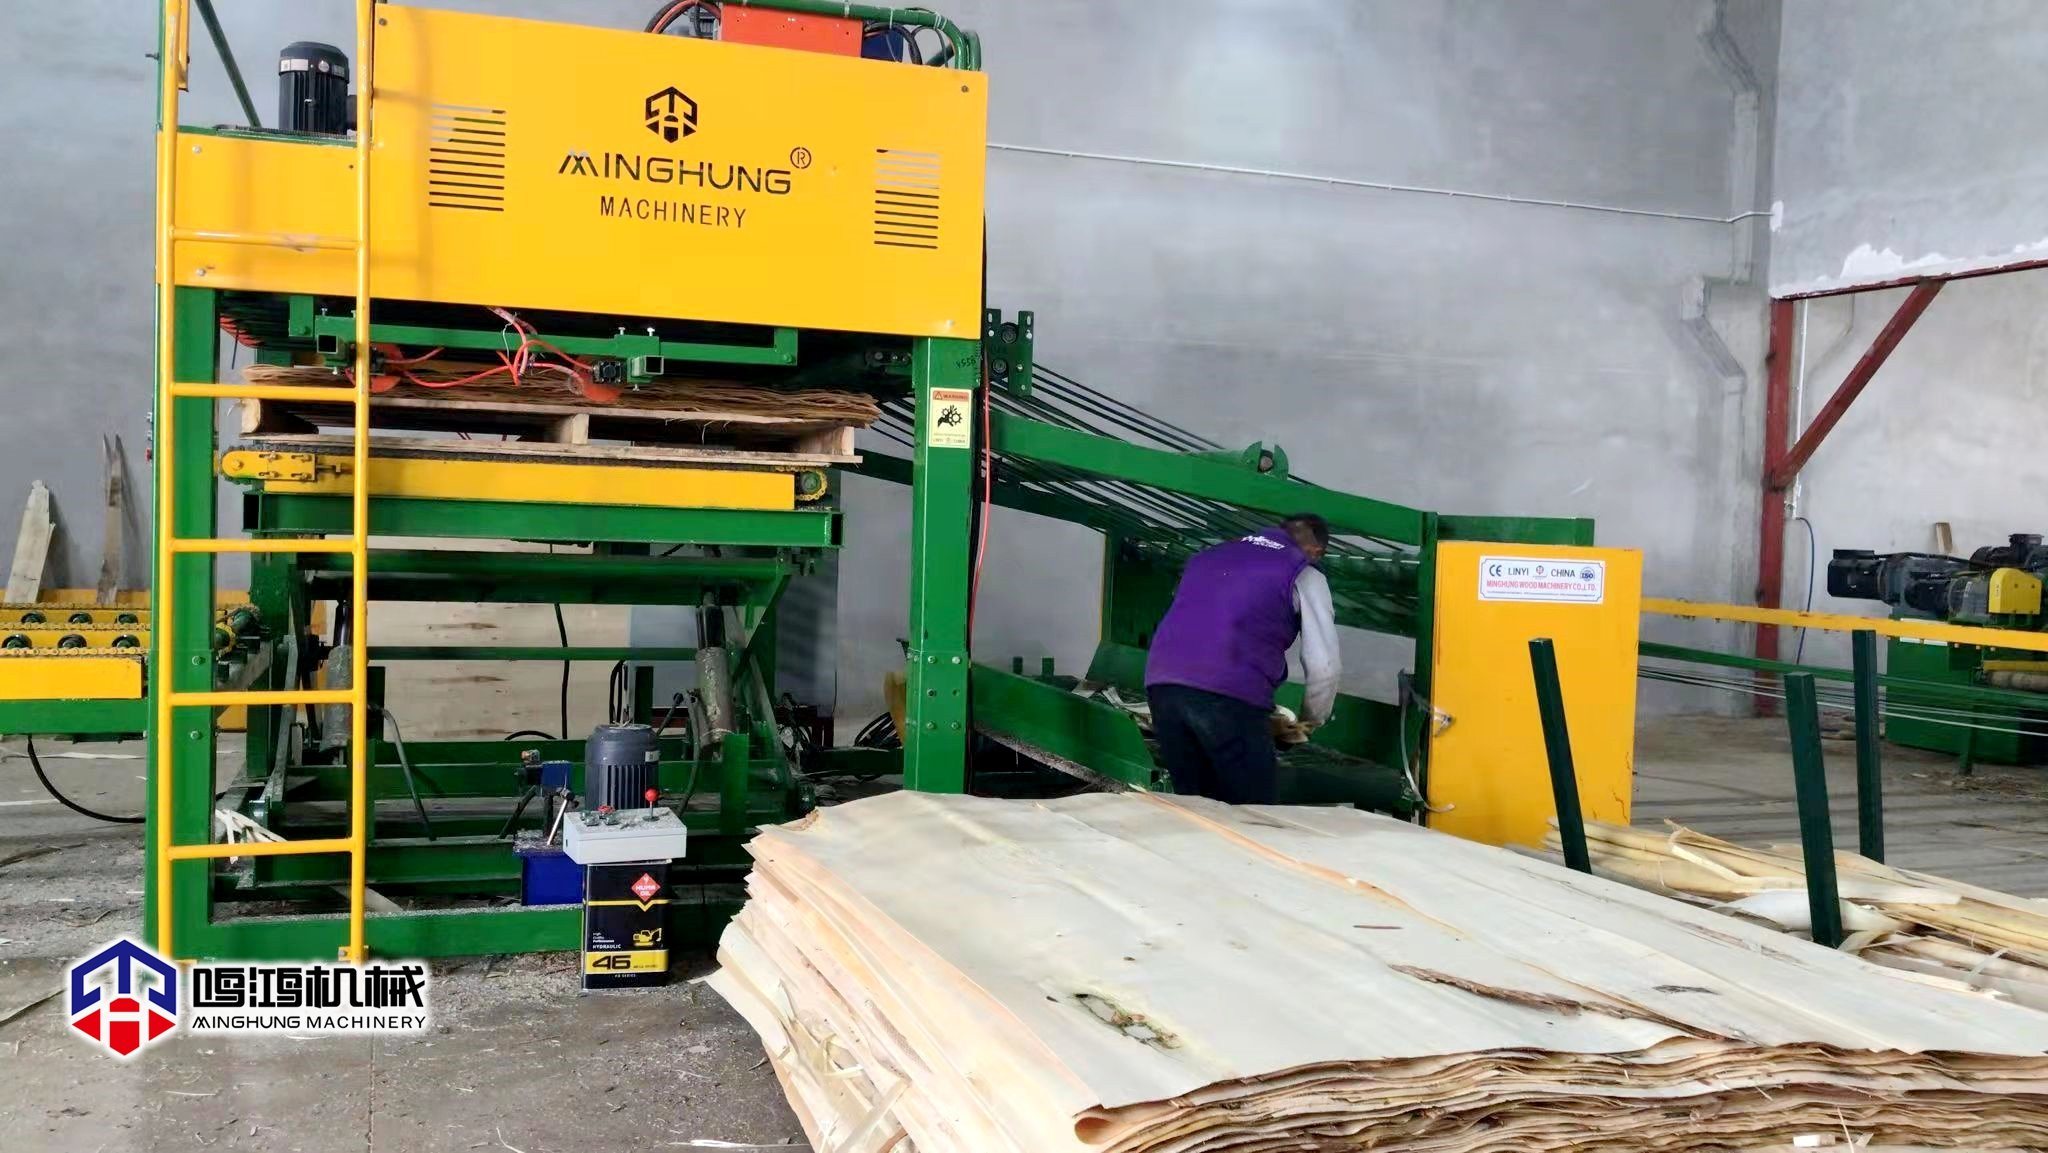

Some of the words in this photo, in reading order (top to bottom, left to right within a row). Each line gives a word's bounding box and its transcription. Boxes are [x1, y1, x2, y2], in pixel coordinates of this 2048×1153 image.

[558, 149, 792, 195] MINGHUNG
[600, 195, 747, 228] MACHINERY
[1508, 567, 1529, 576] LINYI
[1550, 568, 1575, 578] CHINA
[1486, 580, 1519, 589] MINGHUNG
[1519, 581, 1538, 589] WOOD
[1538, 582, 1572, 590] MACHINERY
[592, 954, 632, 970] 46
